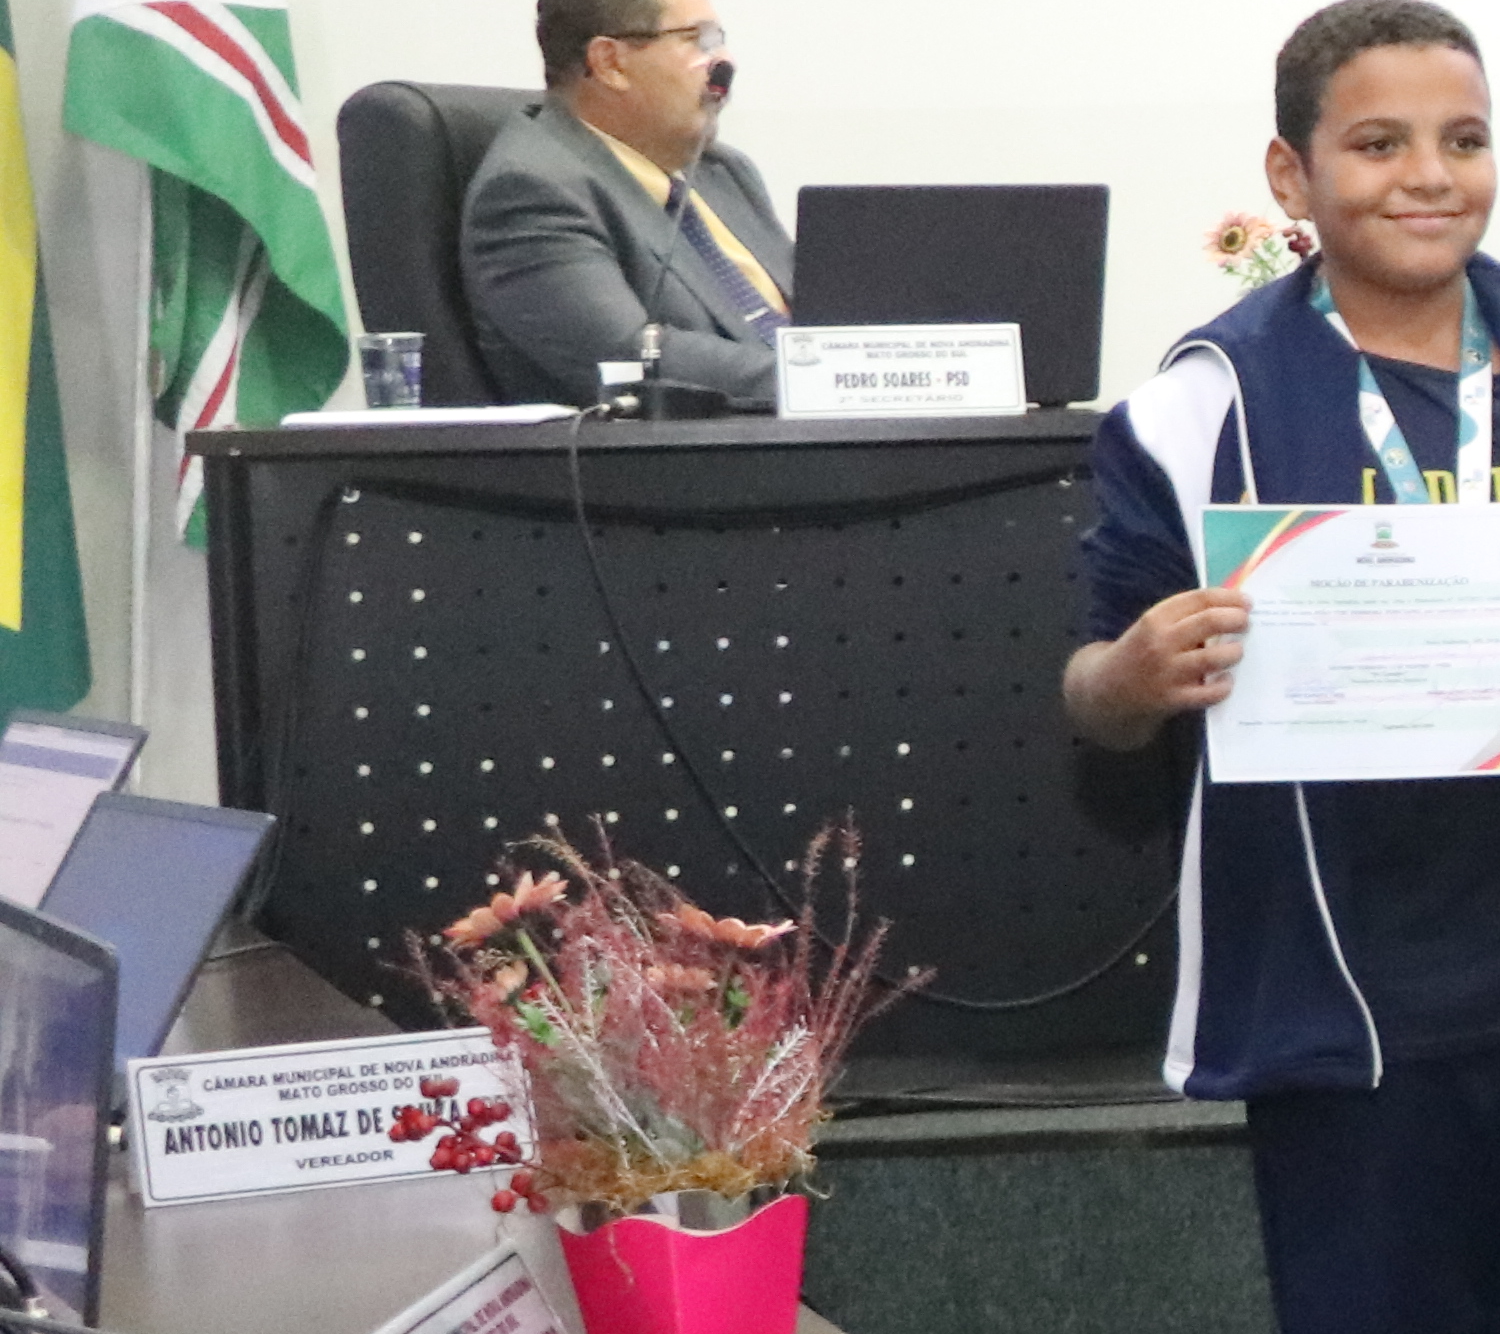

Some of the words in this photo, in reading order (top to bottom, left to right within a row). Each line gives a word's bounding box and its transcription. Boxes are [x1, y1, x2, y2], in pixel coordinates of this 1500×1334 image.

[834, 371, 878, 390] PEDRO
[883, 370, 933, 389] SOARES
[946, 369, 971, 388] PSD
[1309, 577, 1351, 589] MOÇÃO
[1353, 578, 1370, 588] DE
[1371, 576, 1470, 589] PARABENIZAÇÃO
[202, 1071, 268, 1093] CÂMARA
[272, 1065, 355, 1086] MUNICIPAL
[360, 1062, 382, 1079] DE
[384, 1059, 426, 1077] NOVA
[277, 1086, 323, 1102] MATO
[326, 1080, 389, 1100] GROSSO
[392, 1077, 414, 1092] DO
[163, 1118, 263, 1156] ANTONIO
[271, 1110, 349, 1147] TOMAZ
[357, 1107, 385, 1136] DE
[295, 1148, 395, 1170] VEREADOR
